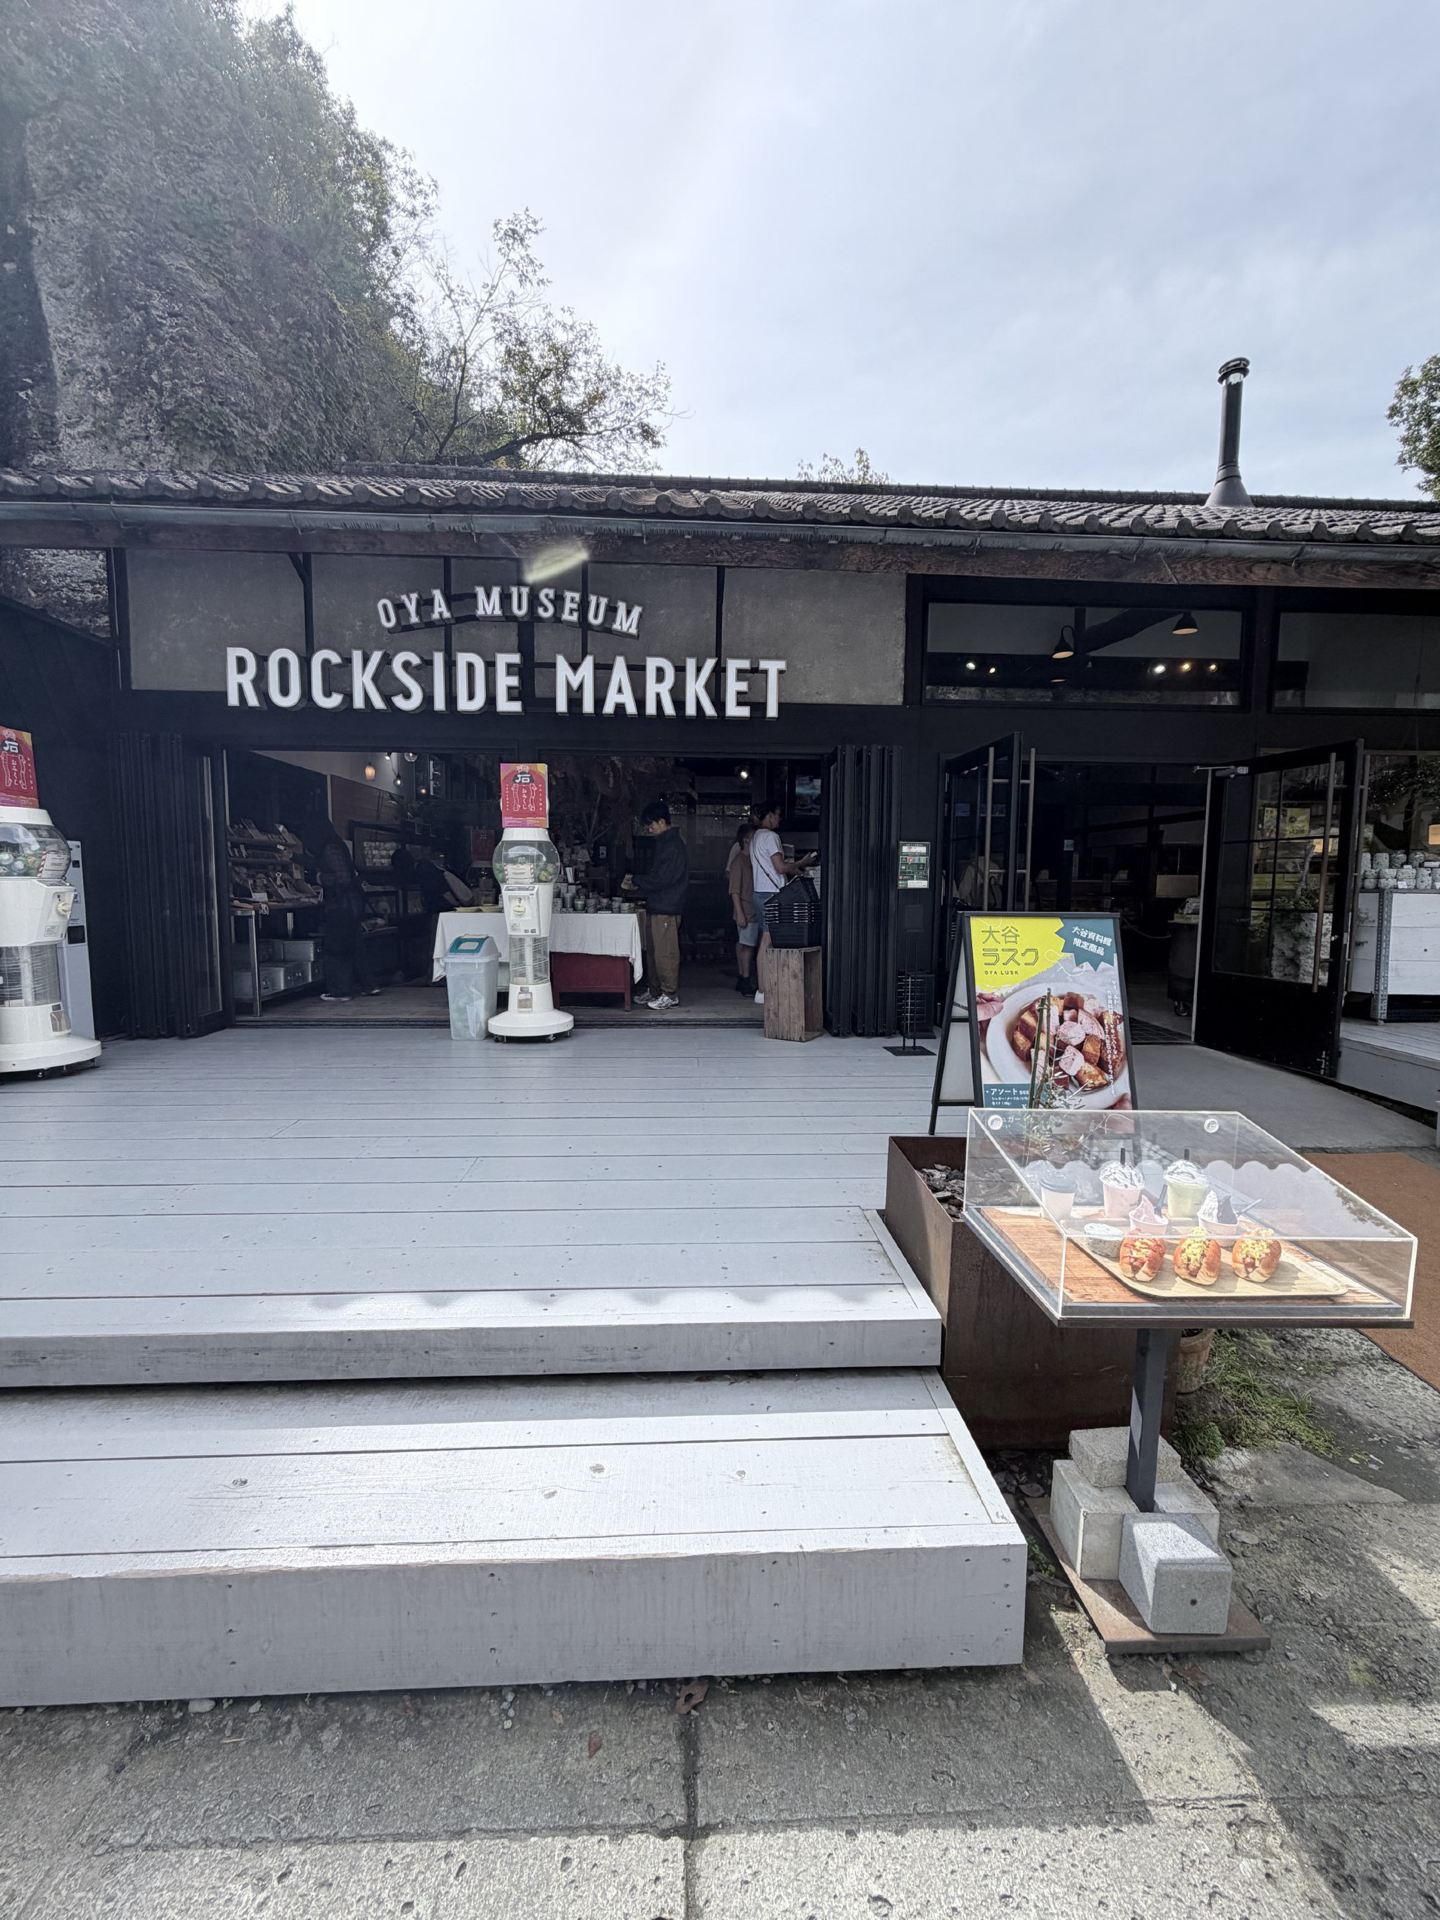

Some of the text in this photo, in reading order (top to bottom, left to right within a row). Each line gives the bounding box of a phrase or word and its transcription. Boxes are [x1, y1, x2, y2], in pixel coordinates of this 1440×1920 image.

[377, 585, 643, 638] OYA MUSEUM
[226, 646, 787, 720] ROCKSIDE MARKET
[981, 925, 1020, 944] 大谷
[982, 948, 1039, 966] ラスク
